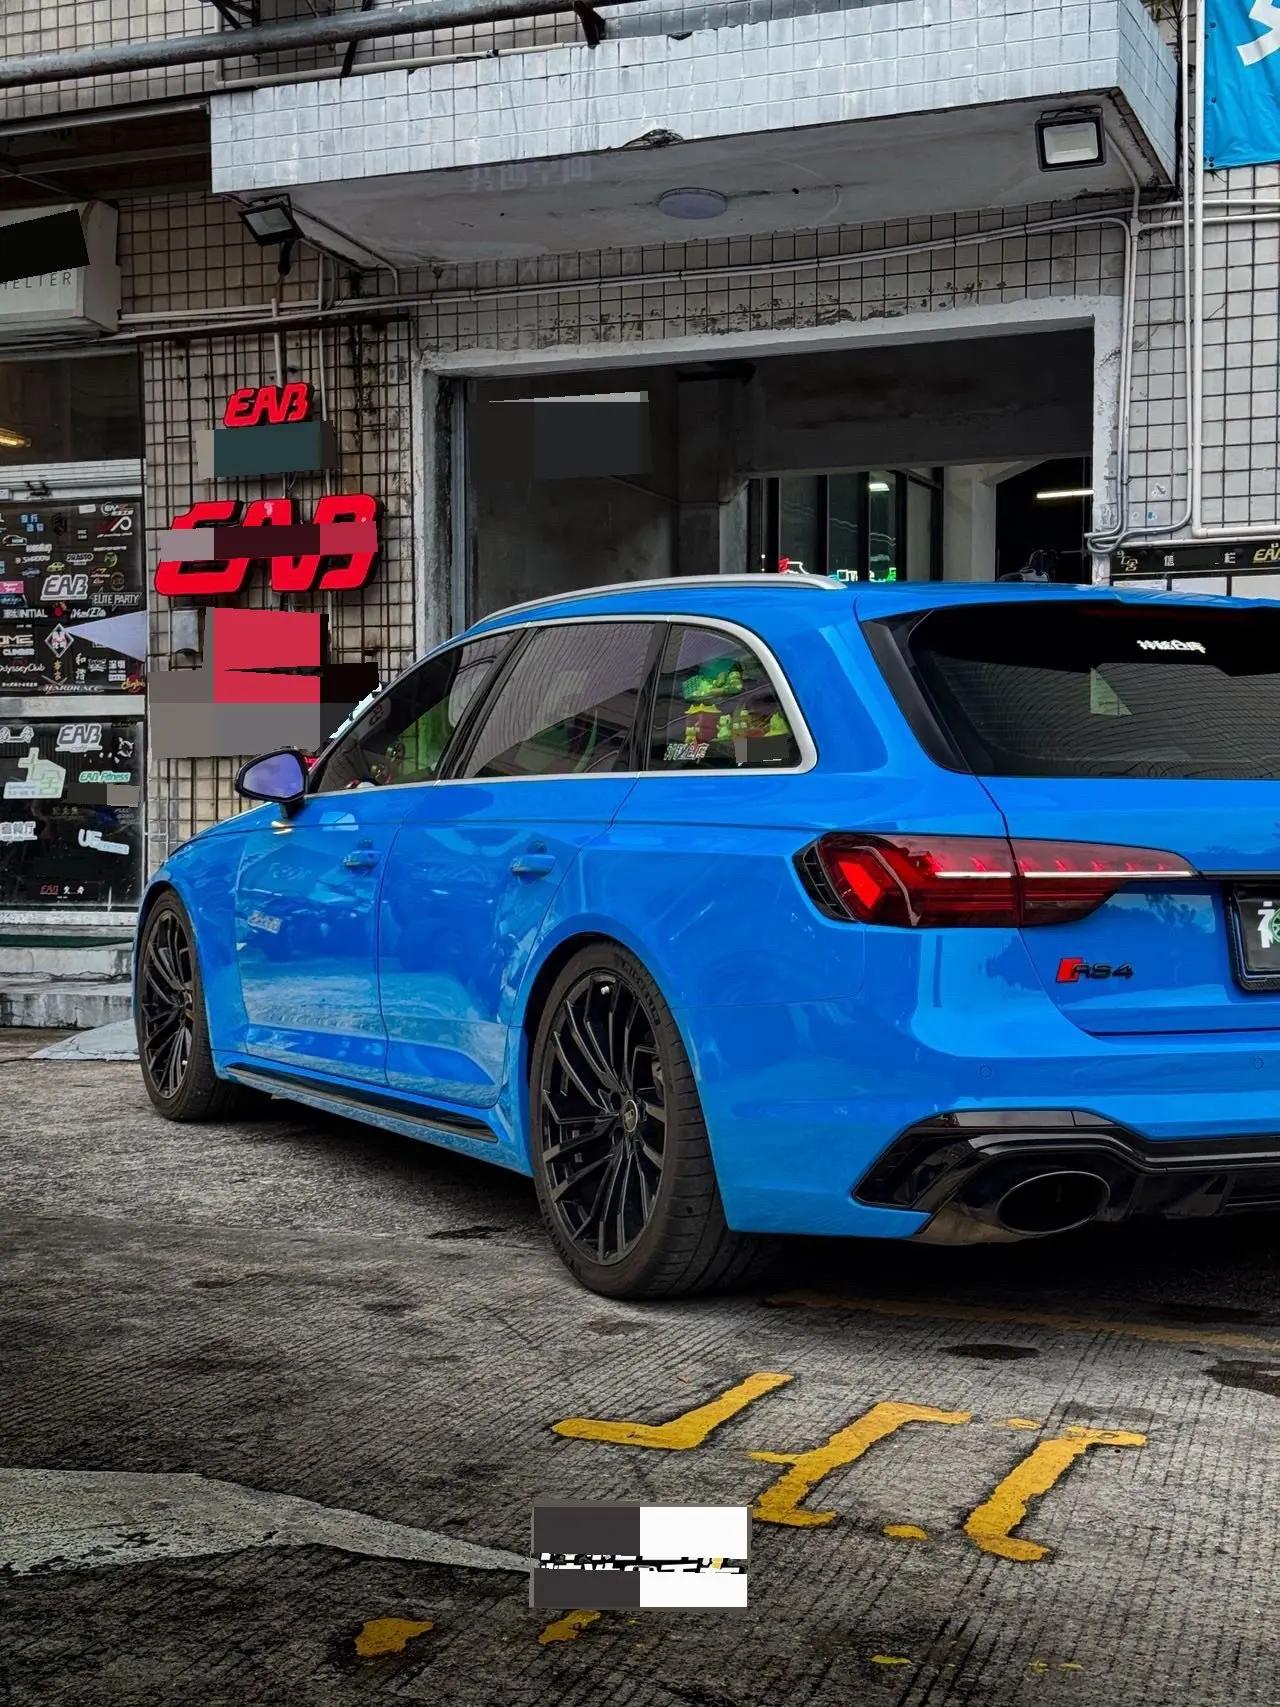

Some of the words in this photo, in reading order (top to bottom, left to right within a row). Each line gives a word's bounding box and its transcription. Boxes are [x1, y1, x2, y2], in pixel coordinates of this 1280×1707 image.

[223, 382, 311, 428] EAB
[42, 575, 88, 597] EAB
[59, 725, 101, 745] EAB
[1066, 961, 1133, 981] RS4
